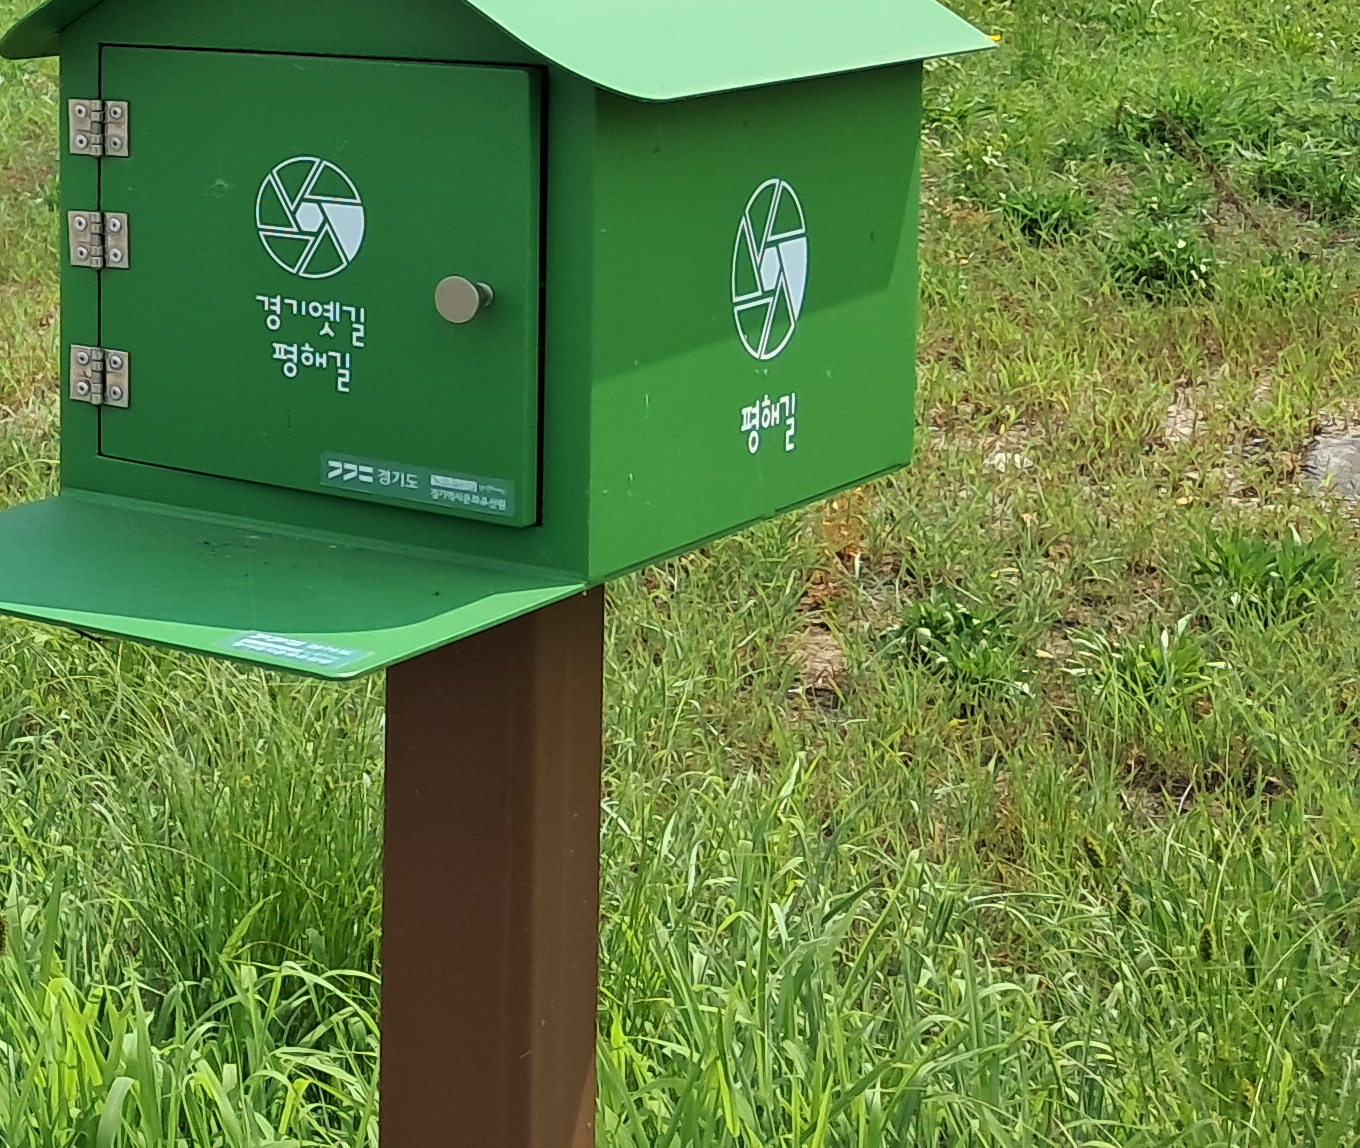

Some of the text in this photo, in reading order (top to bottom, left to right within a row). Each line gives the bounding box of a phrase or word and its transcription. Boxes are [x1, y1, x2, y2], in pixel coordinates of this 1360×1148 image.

[255, 294, 366, 348] 경기옛길
[271, 342, 351, 393] 평해길
[740, 392, 796, 454] 평해길
[377, 468, 419, 490] 경기도
